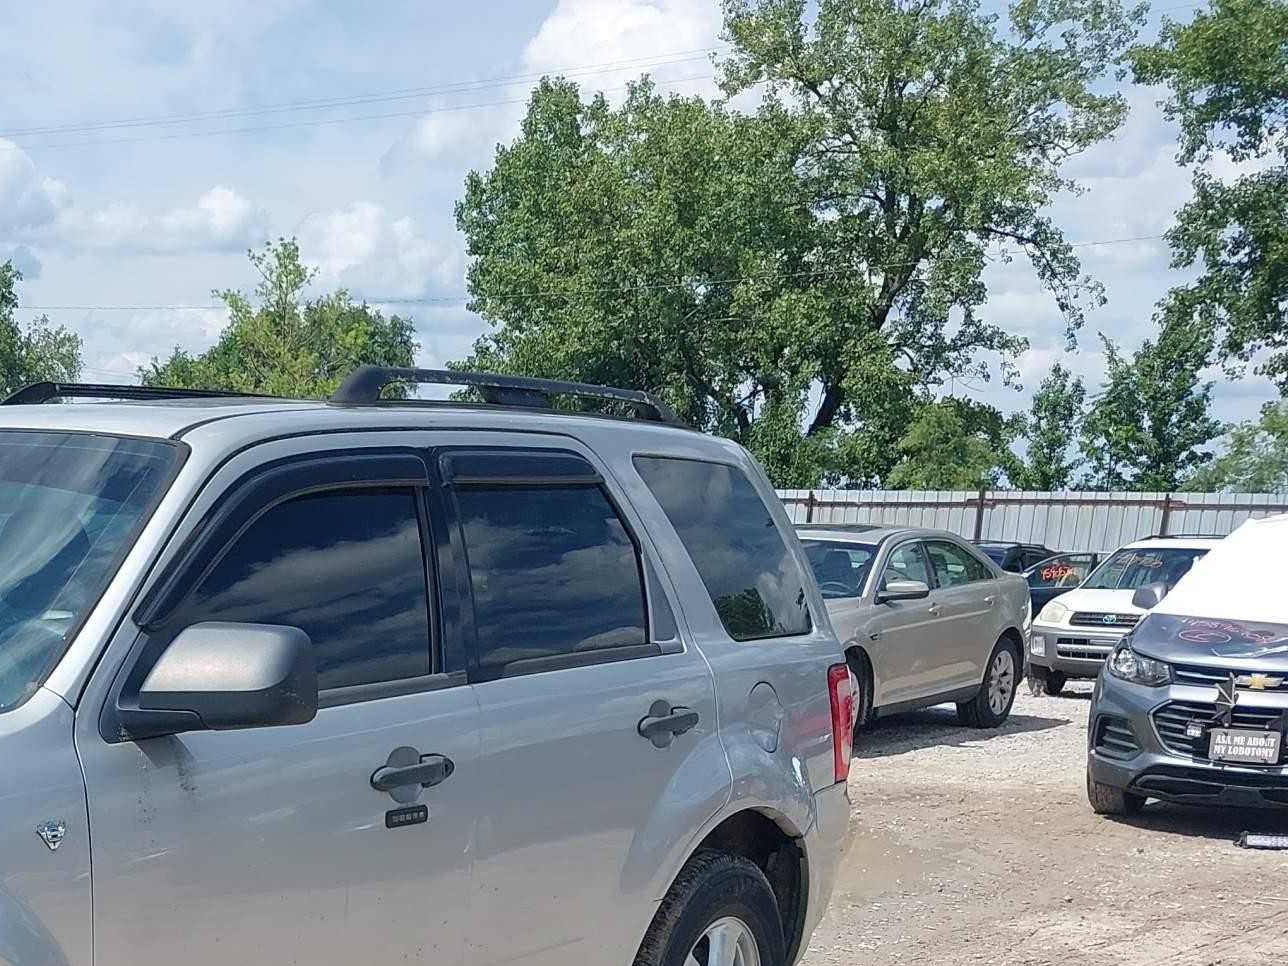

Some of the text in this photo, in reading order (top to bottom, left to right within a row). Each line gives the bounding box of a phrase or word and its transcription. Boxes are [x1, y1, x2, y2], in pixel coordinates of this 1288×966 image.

[1215, 735, 1232, 745] ASK
[1233, 736, 1246, 746] ME
[1213, 744, 1274, 759] MY LOBOTOMY
